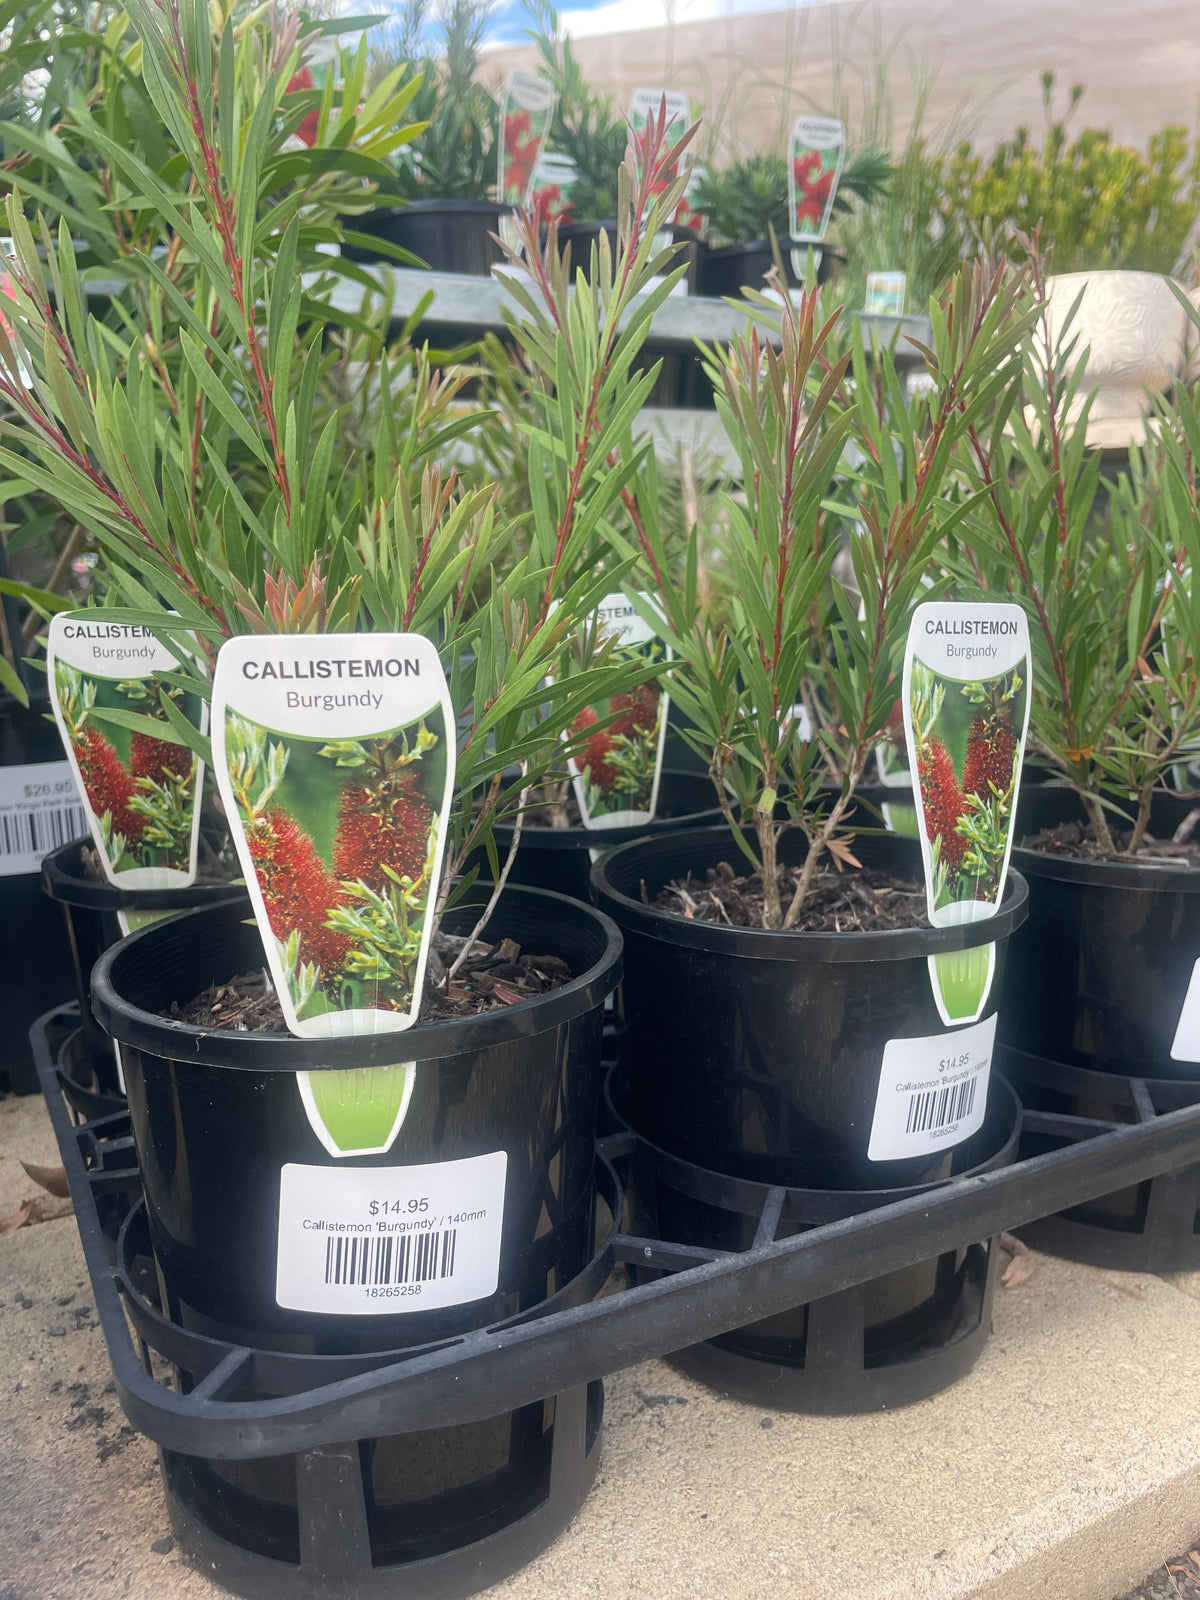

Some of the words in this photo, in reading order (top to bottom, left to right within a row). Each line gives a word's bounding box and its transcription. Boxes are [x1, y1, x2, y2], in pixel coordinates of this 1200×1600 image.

[63, 625, 156, 638] CALLISTEM
[925, 620, 1018, 635] CALLISTEMON
[92, 646, 156, 660] Burgundy
[946, 644, 998, 659] Burgundy
[242, 659, 420, 680] CALLISTEMON
[286, 690, 383, 711] Burgundy
[938, 1053, 970, 1073] $14.95
[895, 1079, 940, 1092] Callistemon
[369, 1198, 429, 1216] $14.95
[302, 1218, 372, 1232] Callistemon
[375, 1217, 437, 1233] 'Burgundy'
[439, 1217, 445, 1226] /
[447, 1208, 487, 1225] 140mm
[364, 1285, 422, 1298] 18265258
